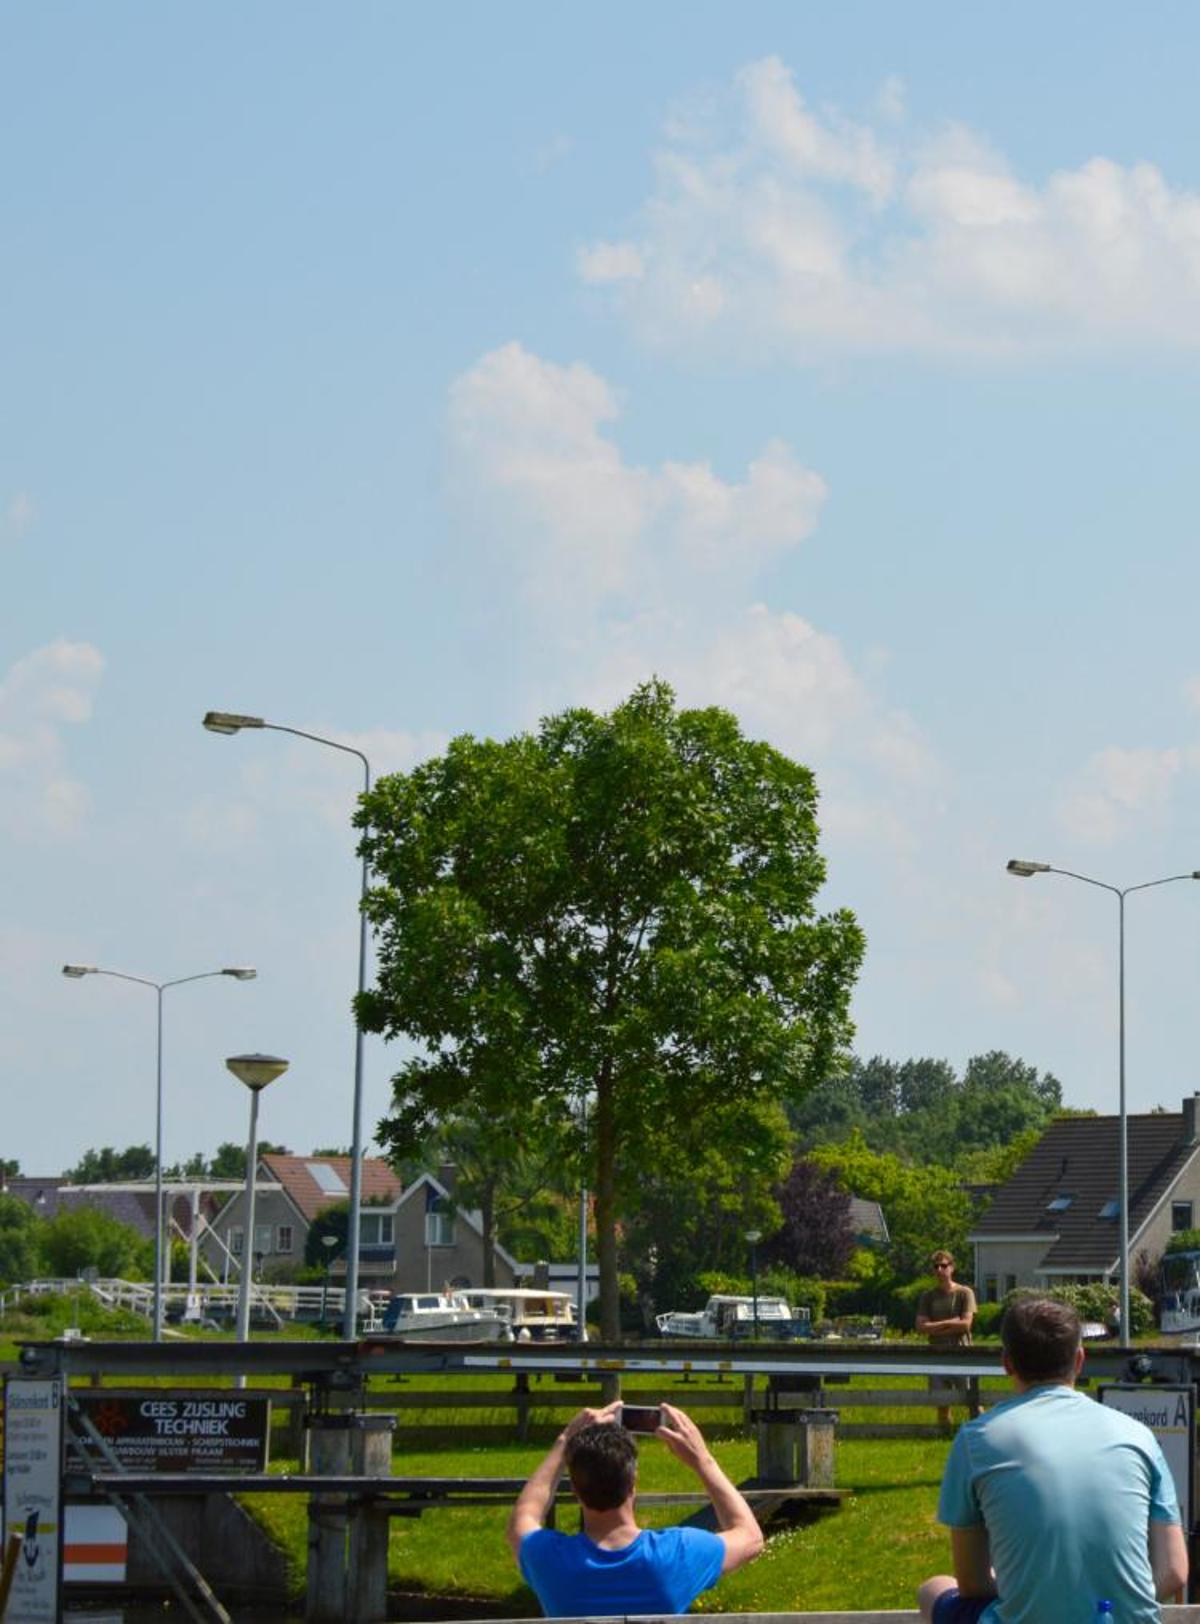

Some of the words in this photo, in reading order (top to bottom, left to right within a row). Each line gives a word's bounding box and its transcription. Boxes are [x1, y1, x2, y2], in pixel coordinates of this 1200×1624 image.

[140, 1402, 178, 1417] CEES
[1173, 1394, 1187, 1427] A
[155, 1419, 228, 1434] TECHNIEK
